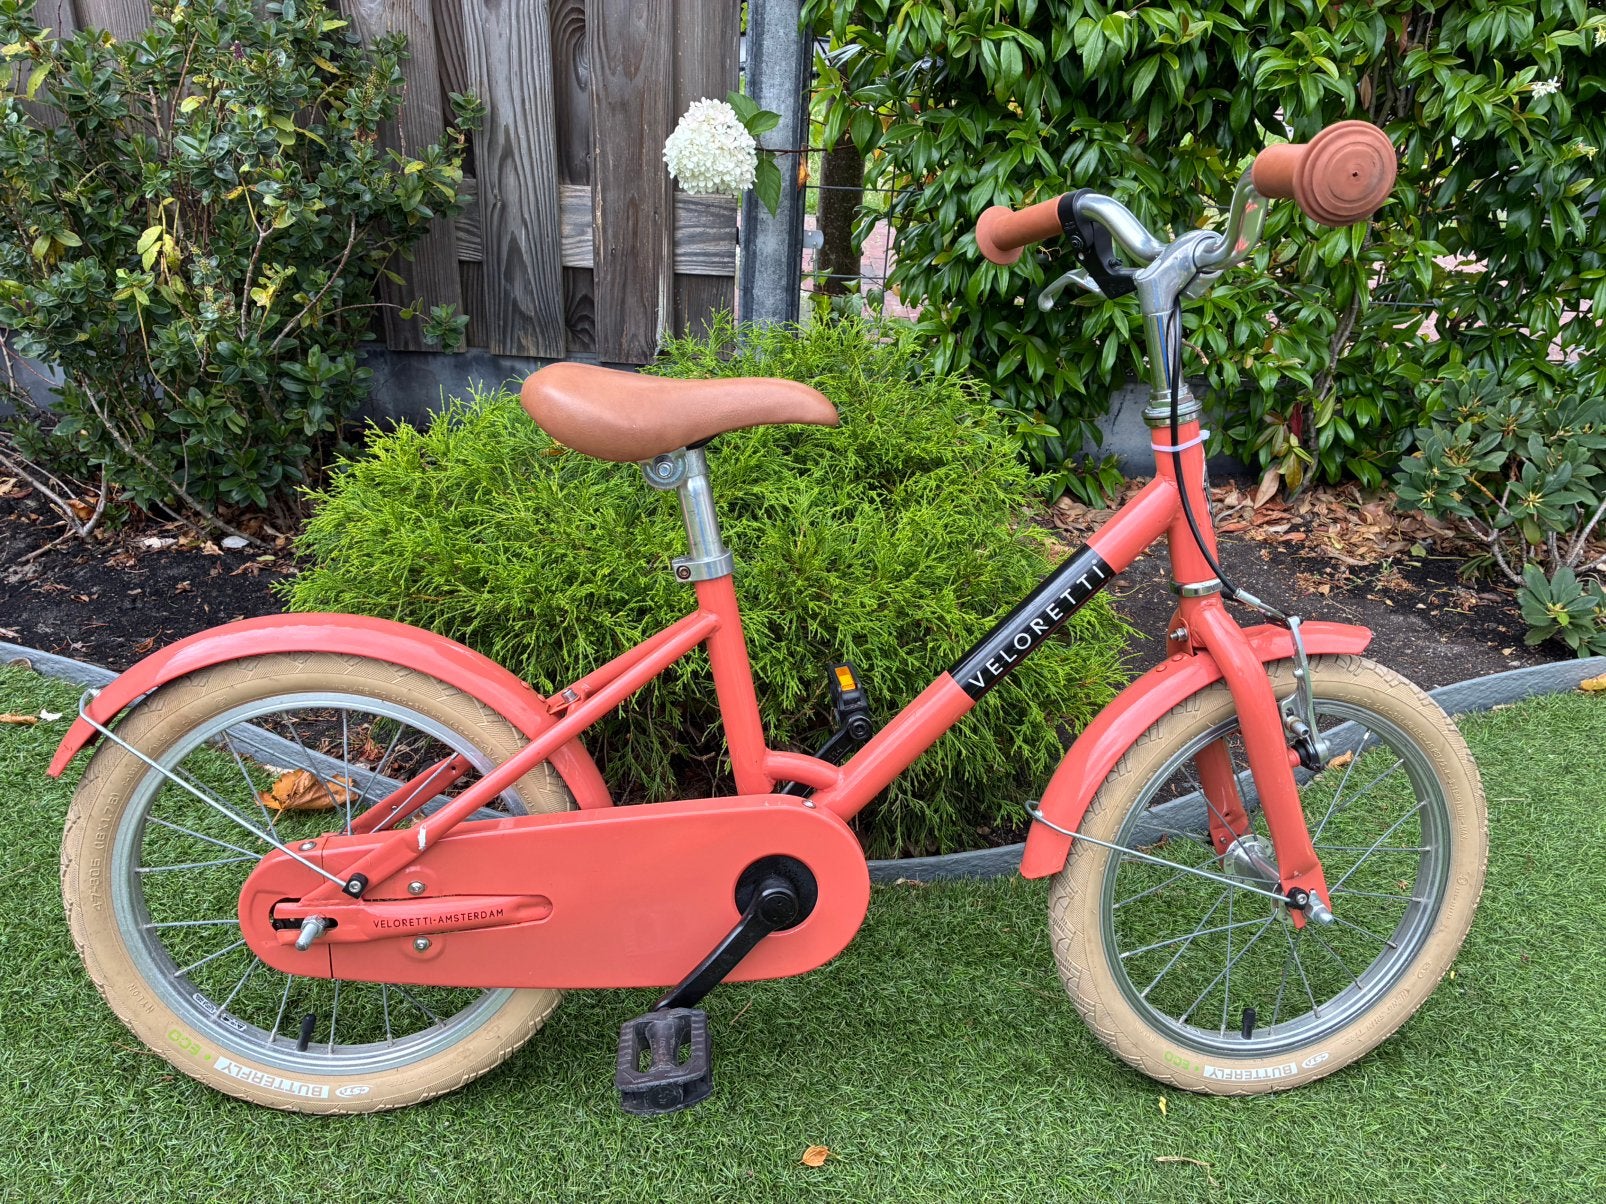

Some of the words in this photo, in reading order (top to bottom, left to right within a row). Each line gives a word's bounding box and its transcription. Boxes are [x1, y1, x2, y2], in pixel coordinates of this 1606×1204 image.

[968, 565, 1105, 688] VELORETTI
[168, 1028, 201, 1056] ECO
[1164, 1051, 1190, 1071] ECO
[1209, 1064, 1292, 1080] BUTTERFLY
[221, 1062, 323, 1097] BUTTERFLY
